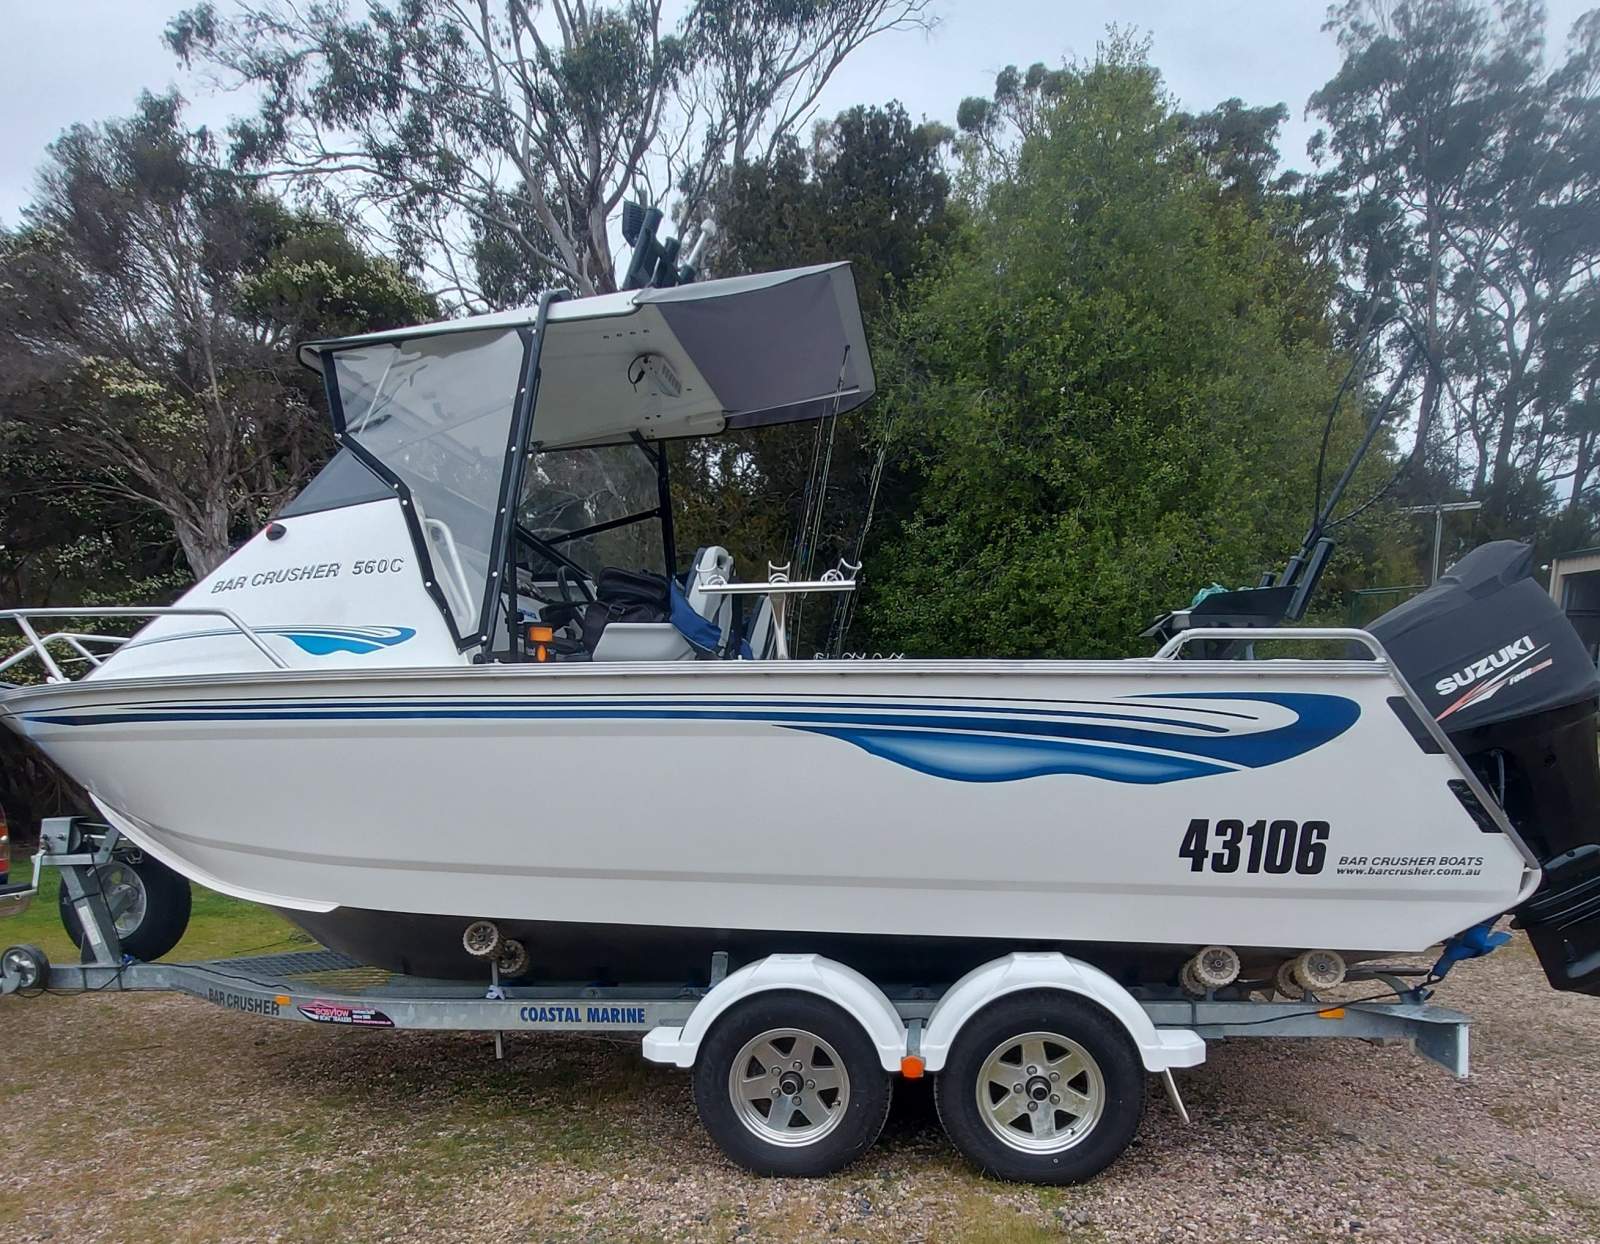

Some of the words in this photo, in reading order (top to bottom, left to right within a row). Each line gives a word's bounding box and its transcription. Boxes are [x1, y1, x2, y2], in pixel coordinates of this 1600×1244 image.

[211, 576, 247, 594] BAR
[251, 562, 342, 587] CRUSHER
[352, 558, 404, 576] 560C
[1435, 635, 1535, 696] SUZUKI
[1178, 818, 1330, 875] 43106
[1336, 866, 1481, 876] www.barcrusher.com.au
[1338, 856, 1368, 866] BAR
[1371, 856, 1437, 866] CRUSHER
[1438, 856, 1484, 866] BOATS
[226, 993, 280, 1016] CRUSHER
[520, 1007, 582, 1022] COASTAL
[587, 1007, 645, 1023] MARINE
